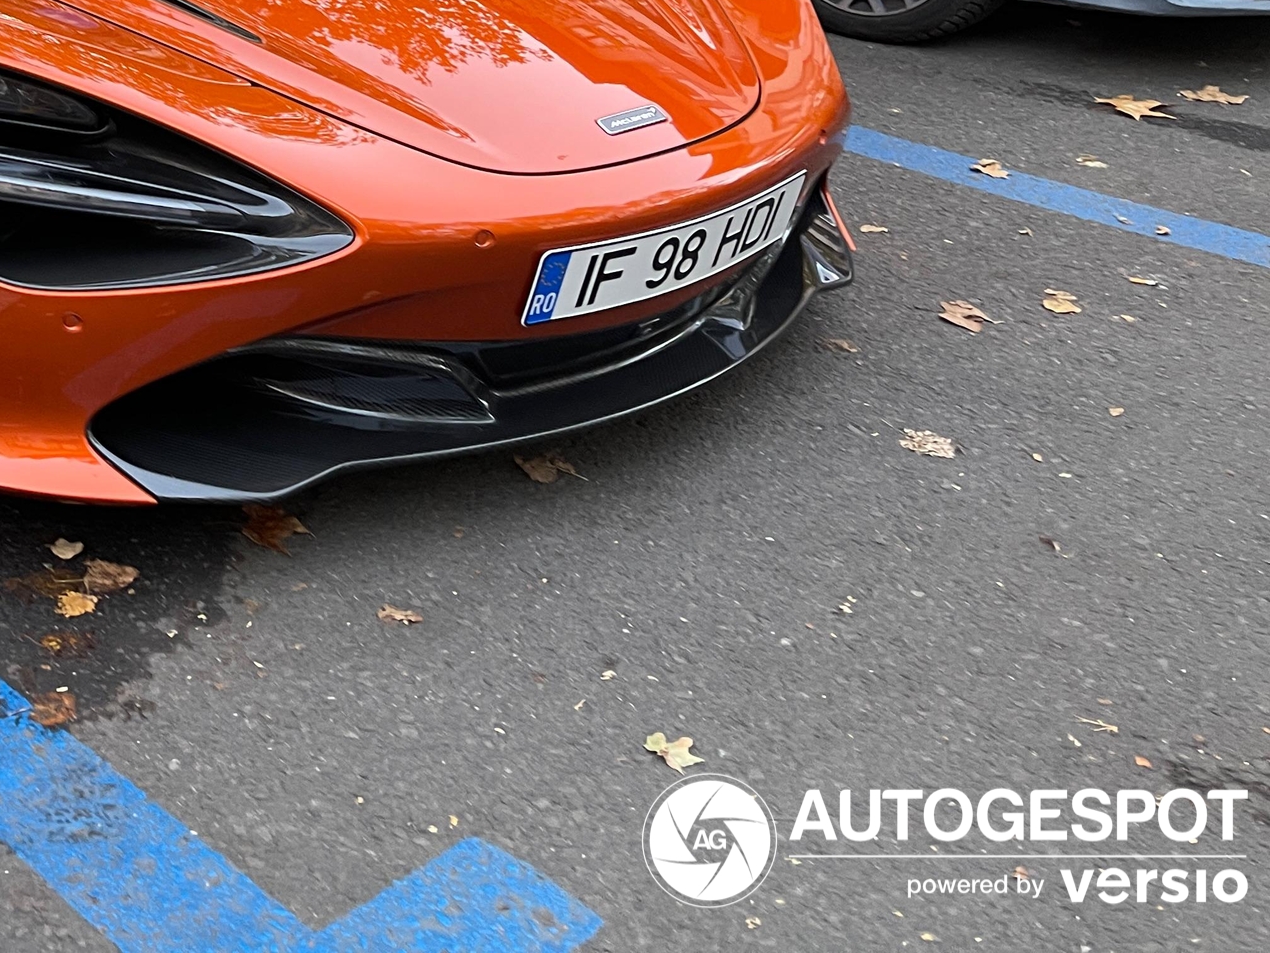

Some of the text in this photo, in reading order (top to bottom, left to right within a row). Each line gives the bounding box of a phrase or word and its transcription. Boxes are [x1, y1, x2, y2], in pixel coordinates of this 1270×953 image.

[529, 190, 786, 316] RO IF 98 HDI
